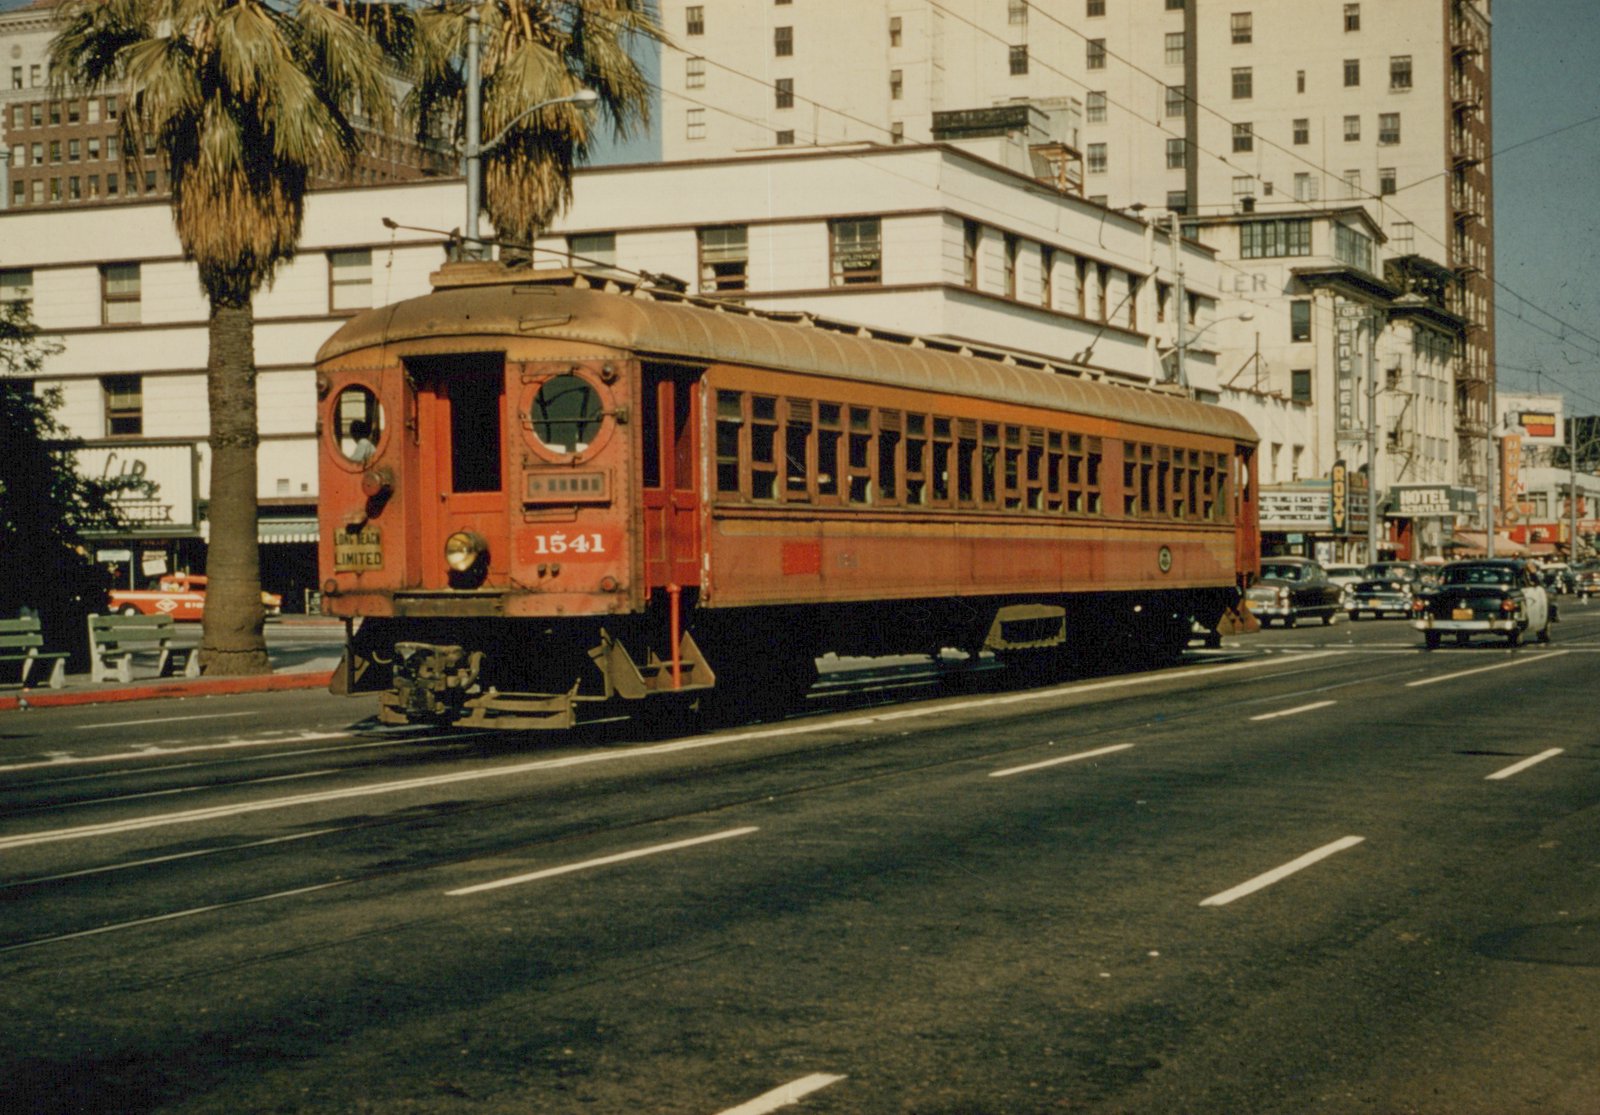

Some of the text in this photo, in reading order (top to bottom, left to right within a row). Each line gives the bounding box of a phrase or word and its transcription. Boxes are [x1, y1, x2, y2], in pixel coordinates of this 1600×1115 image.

[1333, 466, 1345, 528] ROXY
[1400, 489, 1450, 505] HOTEL
[535, 533, 605, 554] 1541
[335, 552, 382, 565] LIMITED
